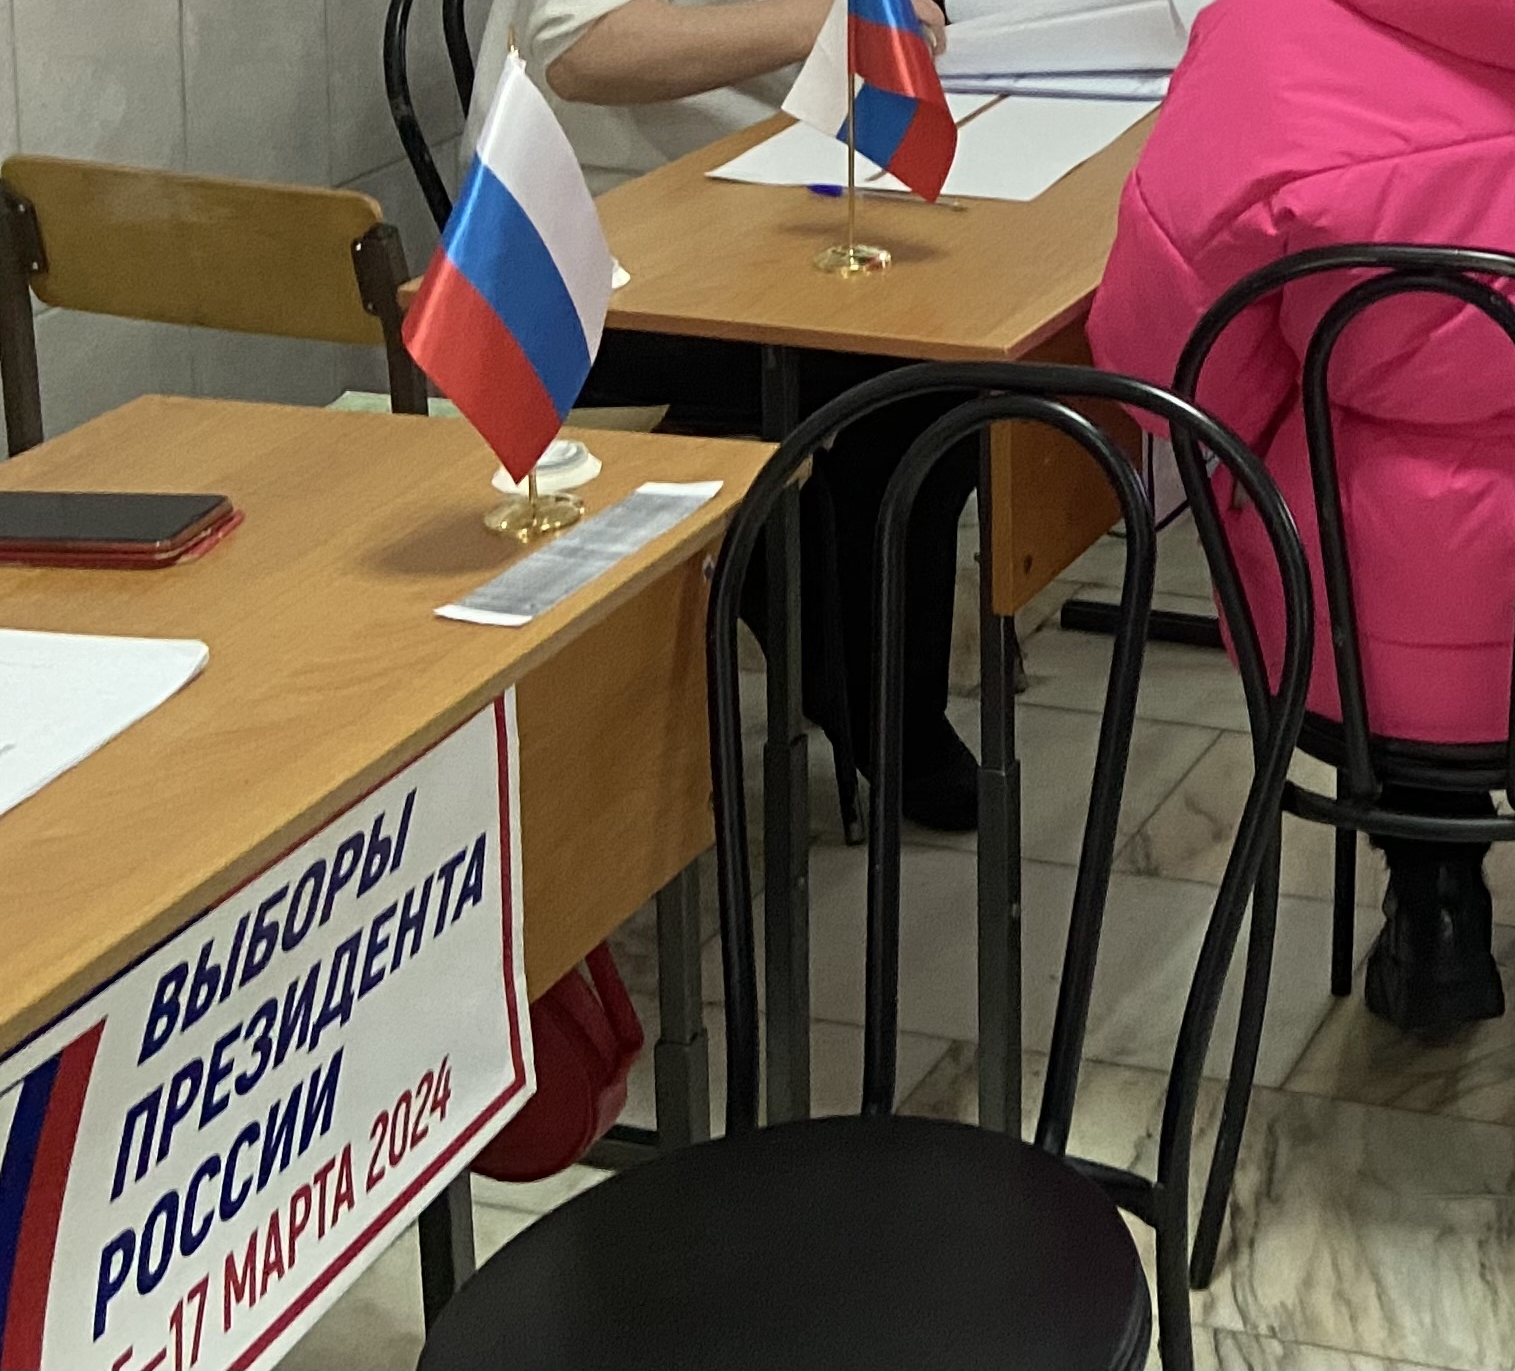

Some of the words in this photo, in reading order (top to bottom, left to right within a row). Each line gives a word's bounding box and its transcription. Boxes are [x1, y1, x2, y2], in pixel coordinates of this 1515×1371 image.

[110, 832, 487, 1203] ПРЕЗИДЕНТА
[137, 788, 418, 1067] ВЫБОРЫ
[93, 1046, 345, 1342] РОССИИ
[223, 1142, 356, 1332] МАРТА
[365, 1053, 452, 1194] 2024
